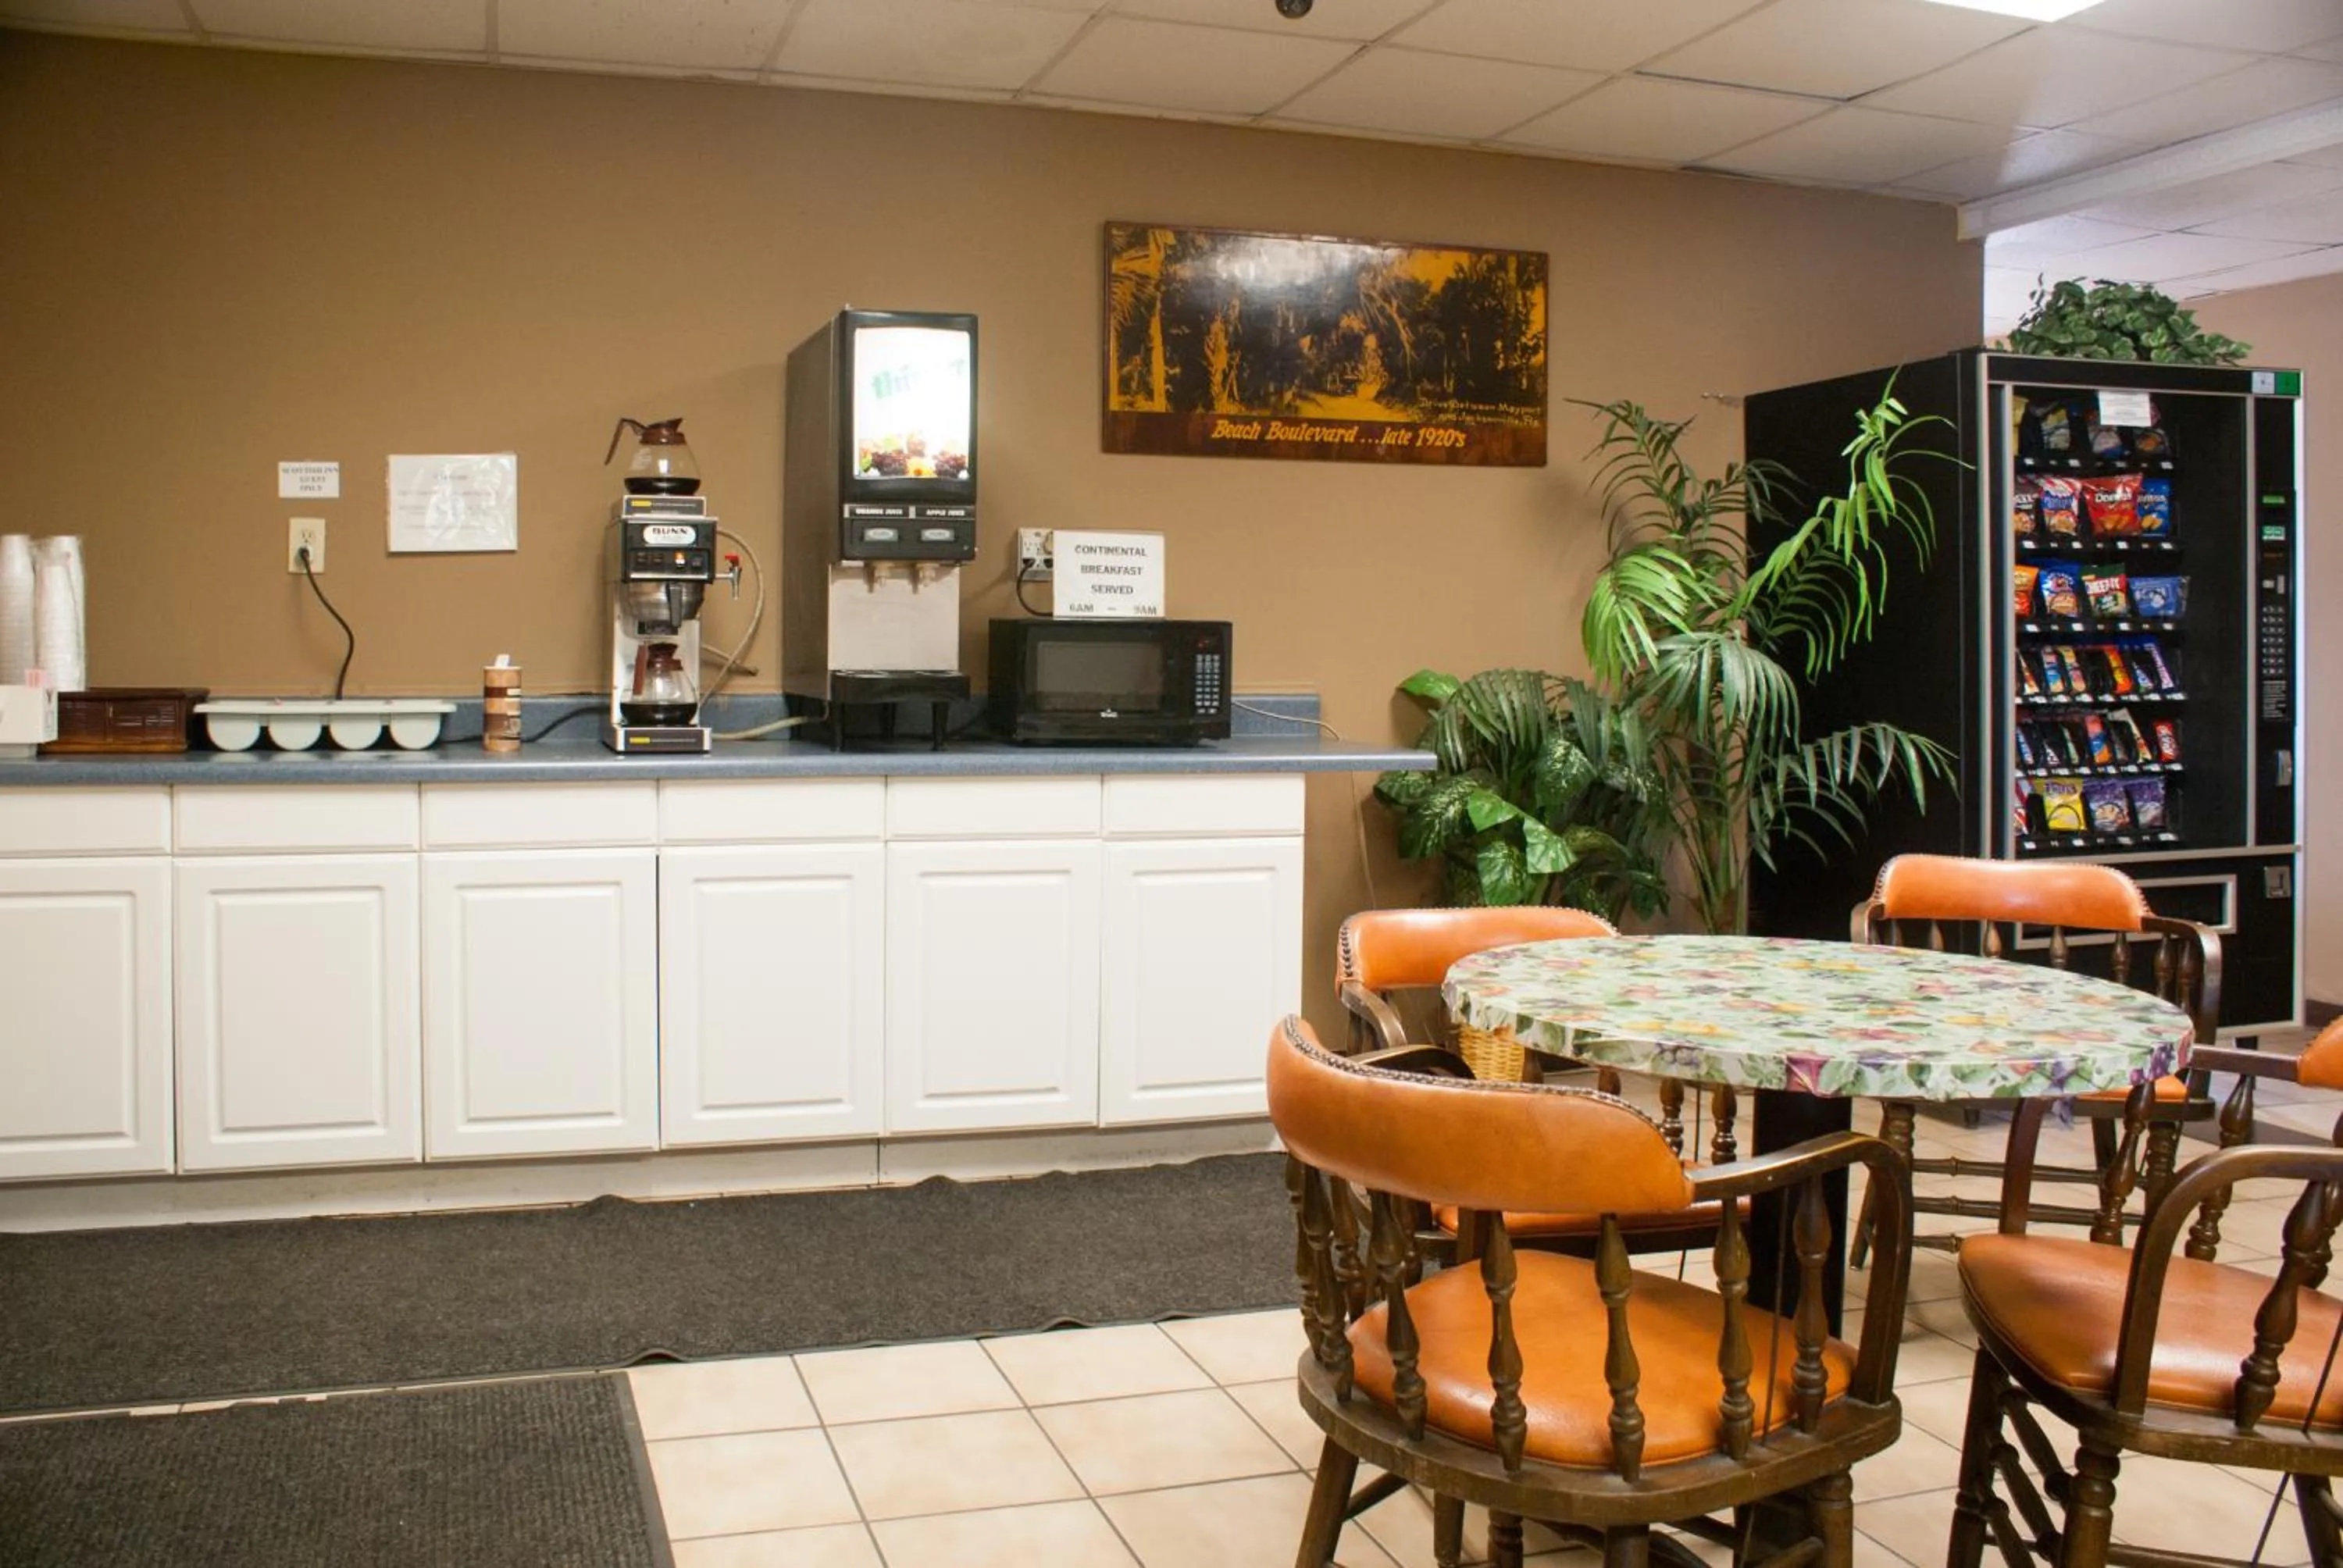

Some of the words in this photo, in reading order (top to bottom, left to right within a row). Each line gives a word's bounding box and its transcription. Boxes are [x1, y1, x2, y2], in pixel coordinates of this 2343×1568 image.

[1211, 419, 1261, 440] Beach
[1265, 421, 1357, 443] Boulevard
[1414, 428, 1466, 447] 1920's
[2095, 492, 2133, 503] Doritos
[1075, 545, 1147, 557] CONTINENTAL
[1081, 565, 1143, 576] BREAKFAST
[1091, 584, 1134, 594] SERVED
[1069, 604, 1093, 612] 6AM
[1134, 604, 1157, 615] 9AM
